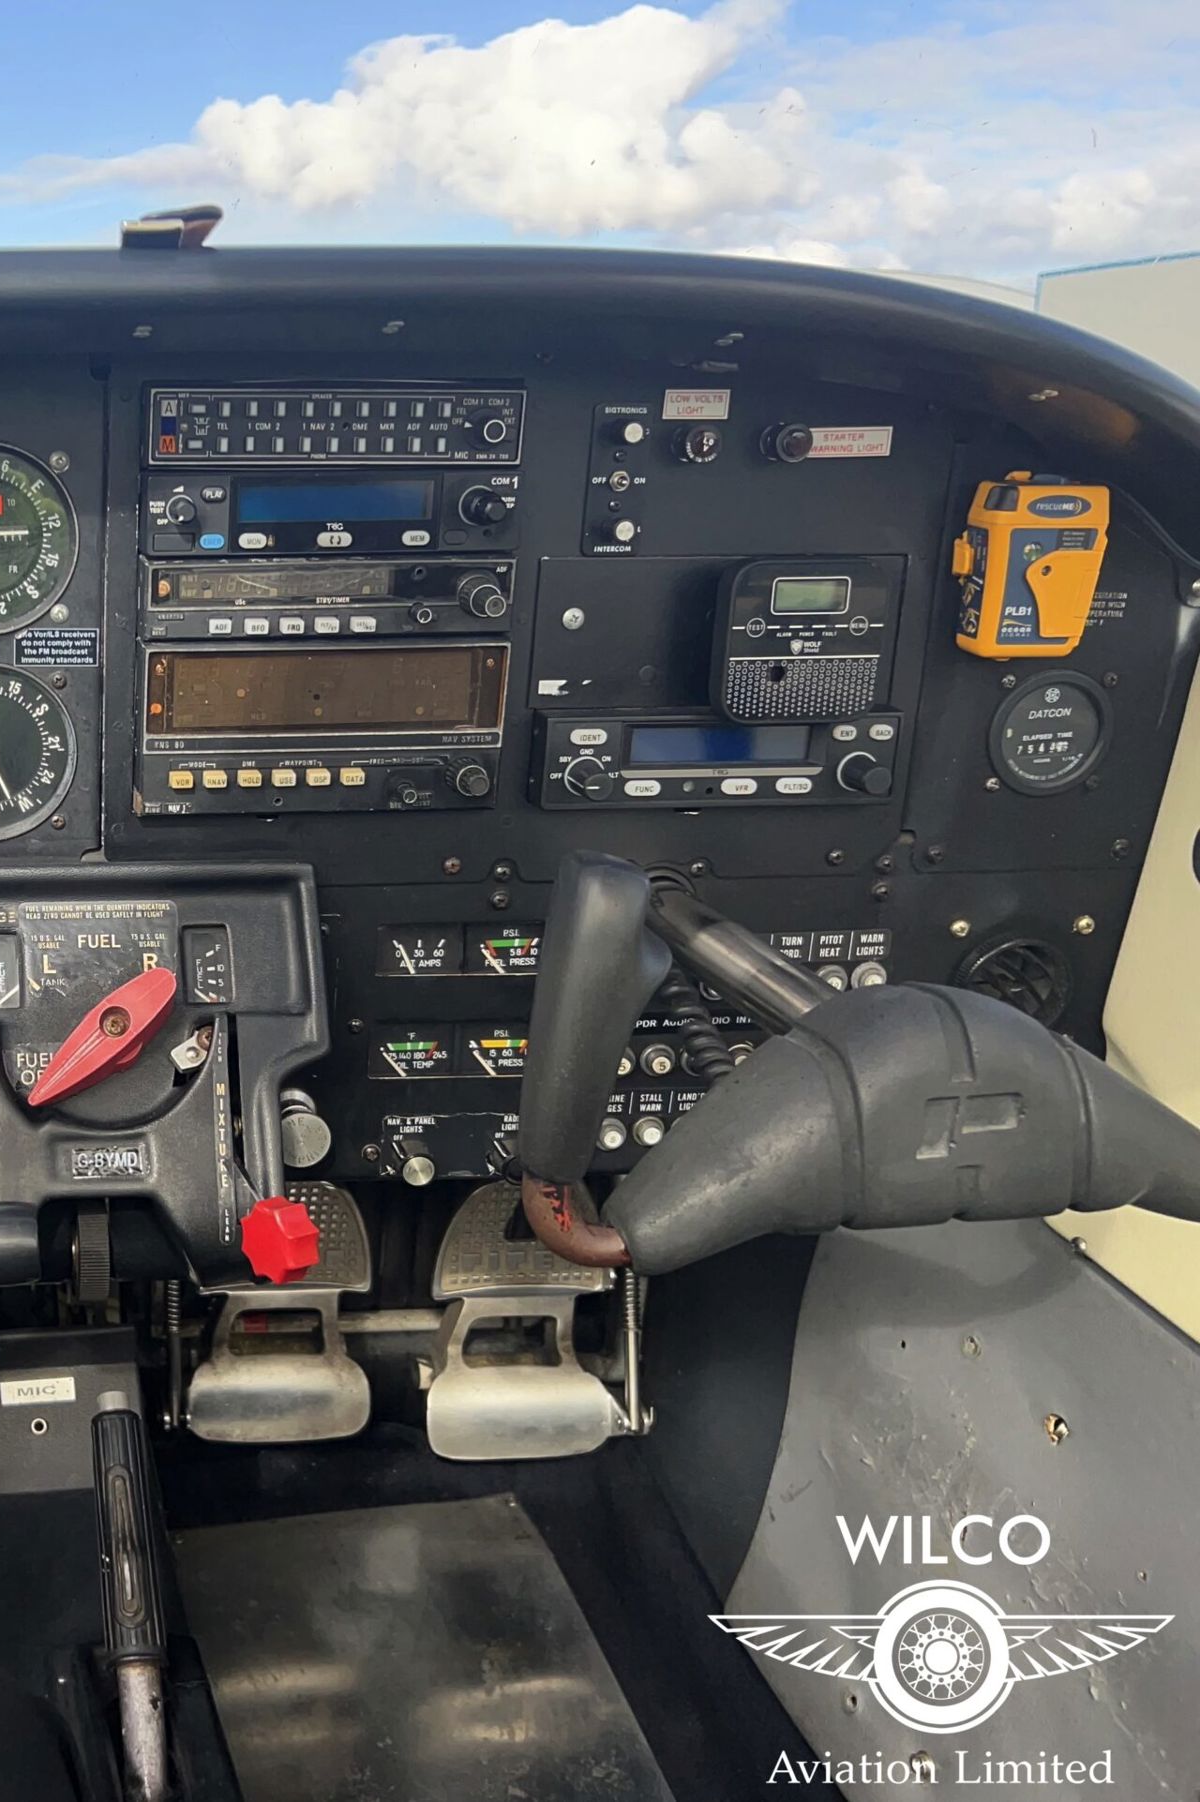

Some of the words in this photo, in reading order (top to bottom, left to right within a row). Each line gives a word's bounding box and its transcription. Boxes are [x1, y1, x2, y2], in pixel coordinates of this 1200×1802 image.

[462, 398, 479, 406] COM
[488, 398, 504, 406] COM
[669, 394, 692, 404] LOW
[695, 394, 724, 404] VOLTS
[676, 406, 705, 415] LIGHT
[216, 422, 229, 431] TEL
[255, 422, 271, 431] COM
[309, 422, 326, 431] NAV
[352, 422, 369, 431] DME
[379, 422, 395, 431] MKR
[406, 422, 421, 431] ADF
[429, 422, 448, 431] AUTO
[823, 432, 865, 443] STARTER
[856, 442, 885, 453] LIGHT
[454, 451, 469, 459] MIC
[491, 477, 510, 486] COM
[205, 489, 225, 499] PLAY
[409, 535, 425, 543] MEM
[26, 584, 40, 599] S
[1004, 606, 1032, 616] PLB1
[214, 623, 228, 631] ADF
[251, 624, 266, 632] BFO
[61, 630, 96, 638] receivers
[33, 639, 46, 647] not
[47, 639, 73, 648] comply
[24, 647, 37, 655] the
[51, 647, 88, 655] broadcast
[56, 656, 94, 664] standards
[1028, 708, 1072, 720] DATCON
[580, 734, 601, 742] IDENT
[1022, 733, 1053, 741] ELAPSED
[1056, 731, 1073, 739] TIME
[188, 761, 207, 769] MODE
[175, 778, 190, 786] VOR
[242, 777, 261, 785] HOLD
[279, 776, 294, 785] USE
[345, 775, 364, 783] DATA
[735, 784, 749, 792] VFR
[60, 911, 83, 919] CANNOT
[77, 934, 122, 949] FUEL
[781, 935, 803, 945] TURN
[819, 934, 844, 945] PITOT
[860, 933, 884, 943] WARN
[819, 947, 841, 957] HEAT
[856, 946, 885, 956] LIGHTS
[42, 954, 57, 974] L
[142, 953, 159, 973] R
[418, 958, 442, 967] AMPS
[509, 957, 536, 966] PRESS
[40, 978, 65, 986] TANK
[413, 1052, 426, 1060] 180
[413, 1060, 435, 1069] TEMP
[498, 1059, 524, 1067] PRESS
[640, 1094, 663, 1102] STALL
[639, 1103, 662, 1112] WARN
[414, 1117, 436, 1125] PANEL
[399, 1125, 424, 1134] LIGHTS
[215, 1083, 229, 1188] MIXTURE
[16, 1385, 58, 1397] MIC
